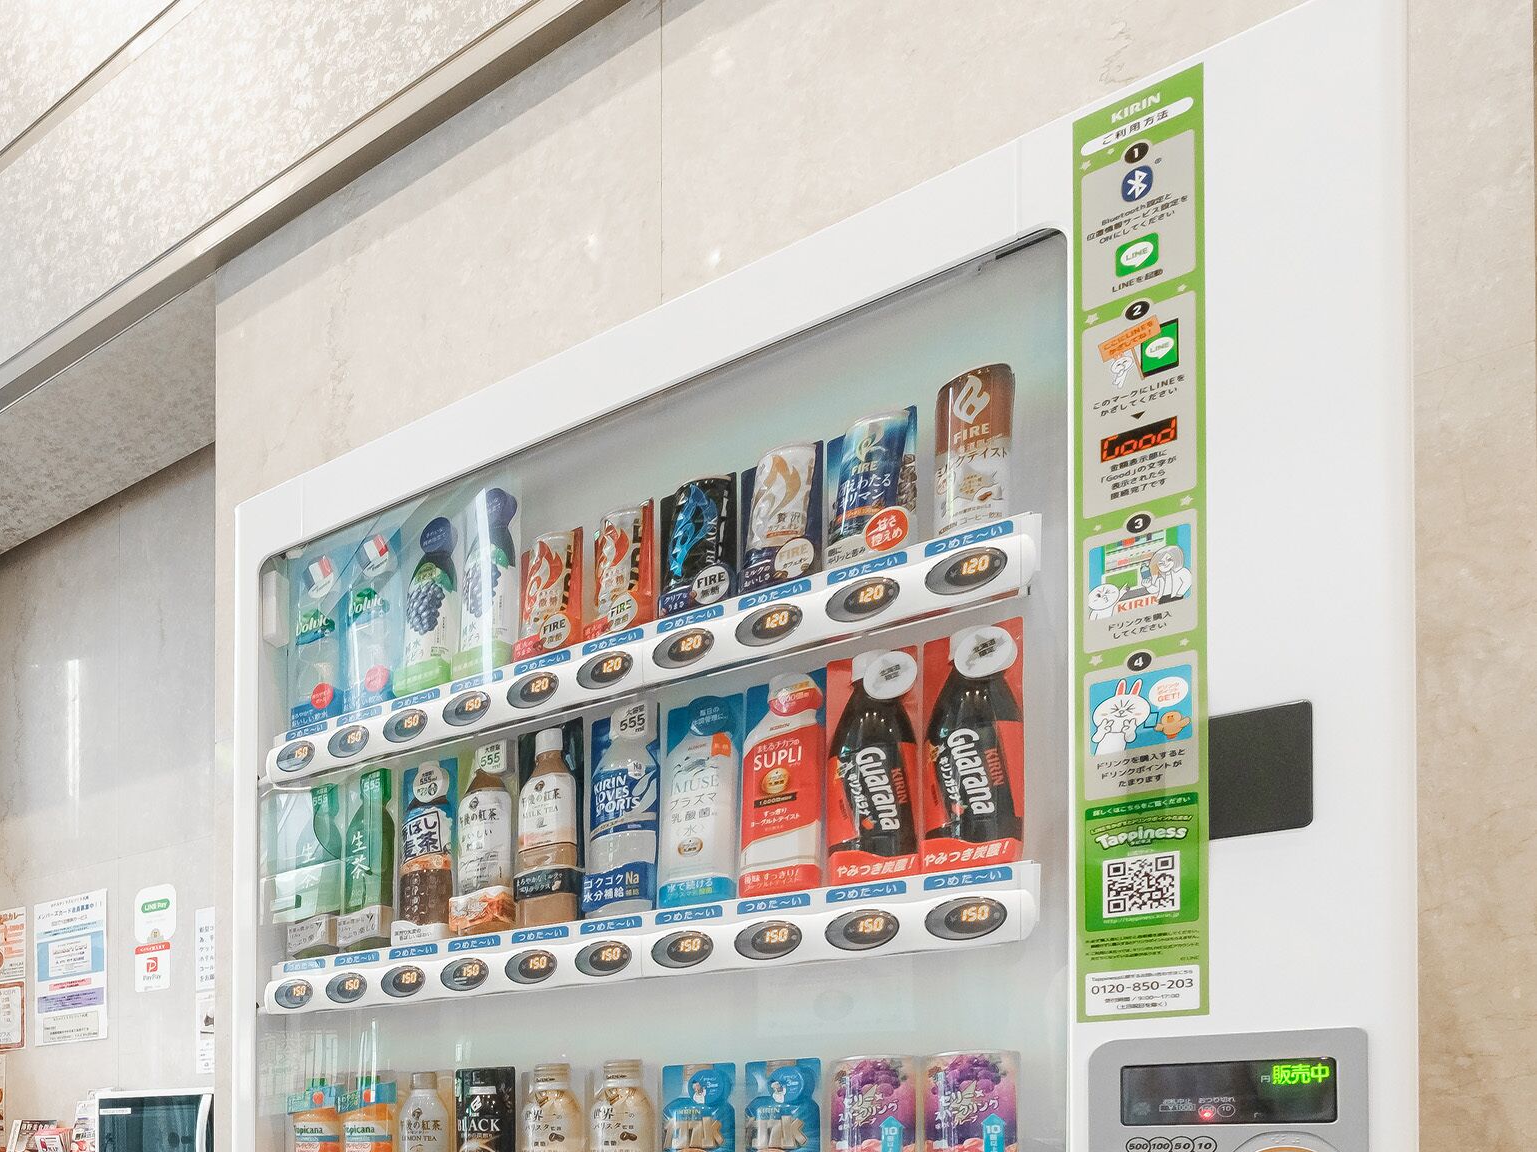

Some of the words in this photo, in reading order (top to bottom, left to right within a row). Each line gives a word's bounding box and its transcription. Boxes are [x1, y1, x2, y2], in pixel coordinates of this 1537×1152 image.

[1111, 91, 1161, 124] KIRIN
[1102, 110, 1169, 146] ご利用方法
[1133, 148, 1140, 159] 1
[1099, 210, 1175, 244] ONにしてください
[1125, 247, 1148, 261] LINE
[1111, 268, 1163, 293] LINEを起動
[1133, 305, 1142, 317] 2
[1092, 374, 1185, 410] このマークにLINEを
[1100, 387, 1178, 417] かざしてください
[953, 423, 990, 445] FIRE
[1111, 469, 1166, 490] 表示されたら
[1135, 519, 1143, 529] 3
[870, 527, 903, 547] 控えめ
[962, 556, 990, 575] 120
[697, 572, 726, 589] FIRE
[859, 584, 884, 603] 120
[610, 599, 632, 617] FIRE
[543, 619, 565, 634] FIRE
[766, 610, 788, 628] 120
[1108, 611, 1172, 631] ドリンクを購入
[1113, 622, 1167, 640] してください
[681, 635, 702, 651] 120
[603, 657, 622, 673] 120
[1134, 657, 1143, 667] 4
[531, 679, 549, 693] 120
[465, 697, 481, 711] 150
[404, 715, 419, 728] 150
[620, 715, 646, 733] 555
[347, 732, 362, 744] 150
[295, 747, 308, 759] 150
[480, 754, 501, 767] 555
[754, 746, 802, 771] SUPLI
[1097, 748, 1185, 770] ドリンクを購入すると
[946, 728, 994, 815] Guarana
[984, 748, 1005, 786] KIRIN
[1101, 759, 1182, 780] ドリンクポイントが
[364, 780, 380, 792] 555
[594, 775, 626, 794] KIRIN
[856, 746, 900, 831] Guarana
[891, 767, 908, 803] KIRIN
[1118, 775, 1163, 788] たまります
[595, 785, 629, 804] LOVES
[671, 792, 717, 811] プラズマ
[546, 805, 559, 815] TEA
[595, 797, 640, 818] SPORTS
[671, 807, 711, 824] 乳酸菌
[763, 807, 787, 818] すっきり
[751, 813, 800, 828] ヨーグルトテイスト
[1095, 825, 1188, 850] Tappiness
[351, 831, 373, 880] 生茶
[924, 841, 1009, 866] やみつき炭酸!
[836, 857, 916, 878] やみつき炭酸!
[625, 872, 640, 885] Na
[583, 887, 624, 903] 水分補給
[961, 905, 989, 921] 150
[859, 917, 883, 933] 150
[764, 928, 789, 943] 150
[680, 938, 701, 951] 150
[529, 956, 546, 969] 150
[601, 947, 621, 961] 150
[402, 971, 417, 983] 150
[463, 964, 480, 977] 150
[293, 986, 306, 997] 150
[345, 978, 360, 990] 150
[1091, 979, 1194, 995] 0120-850-203
[1272, 1063, 1330, 1085] 販売中
[594, 1108, 635, 1121] 世界一の
[839, 1100, 898, 1121] スパークリング
[936, 1098, 1000, 1121] スパークリング
[457, 1118, 501, 1132] BLACK
[1128, 1142, 1148, 1151] 500
[1150, 1142, 1170, 1151] 100
[1174, 1142, 1191, 1151] 50
[1197, 1142, 1212, 1151] 10
